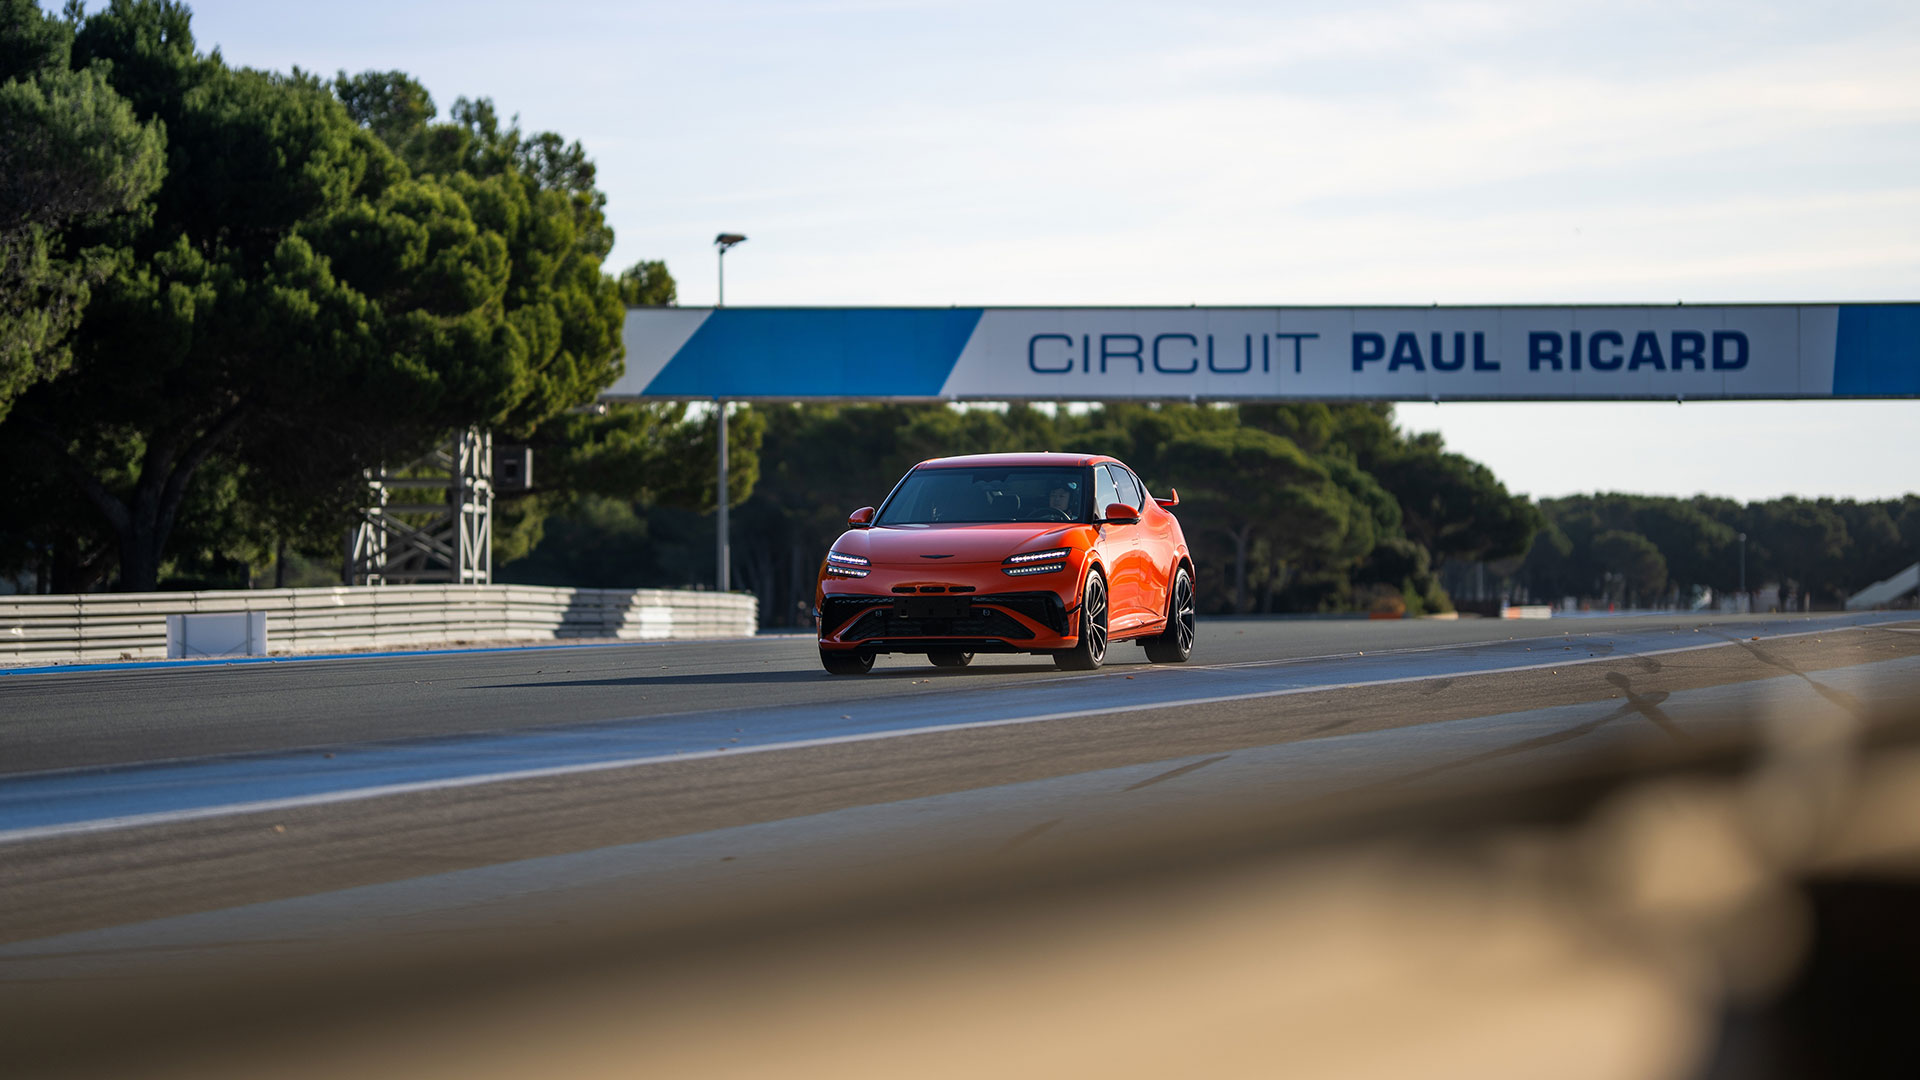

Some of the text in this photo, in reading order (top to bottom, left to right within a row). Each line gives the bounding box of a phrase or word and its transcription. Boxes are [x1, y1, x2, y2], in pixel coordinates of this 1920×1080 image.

[1028, 331, 1749, 374] CIRCUIT PAUL RICARD
